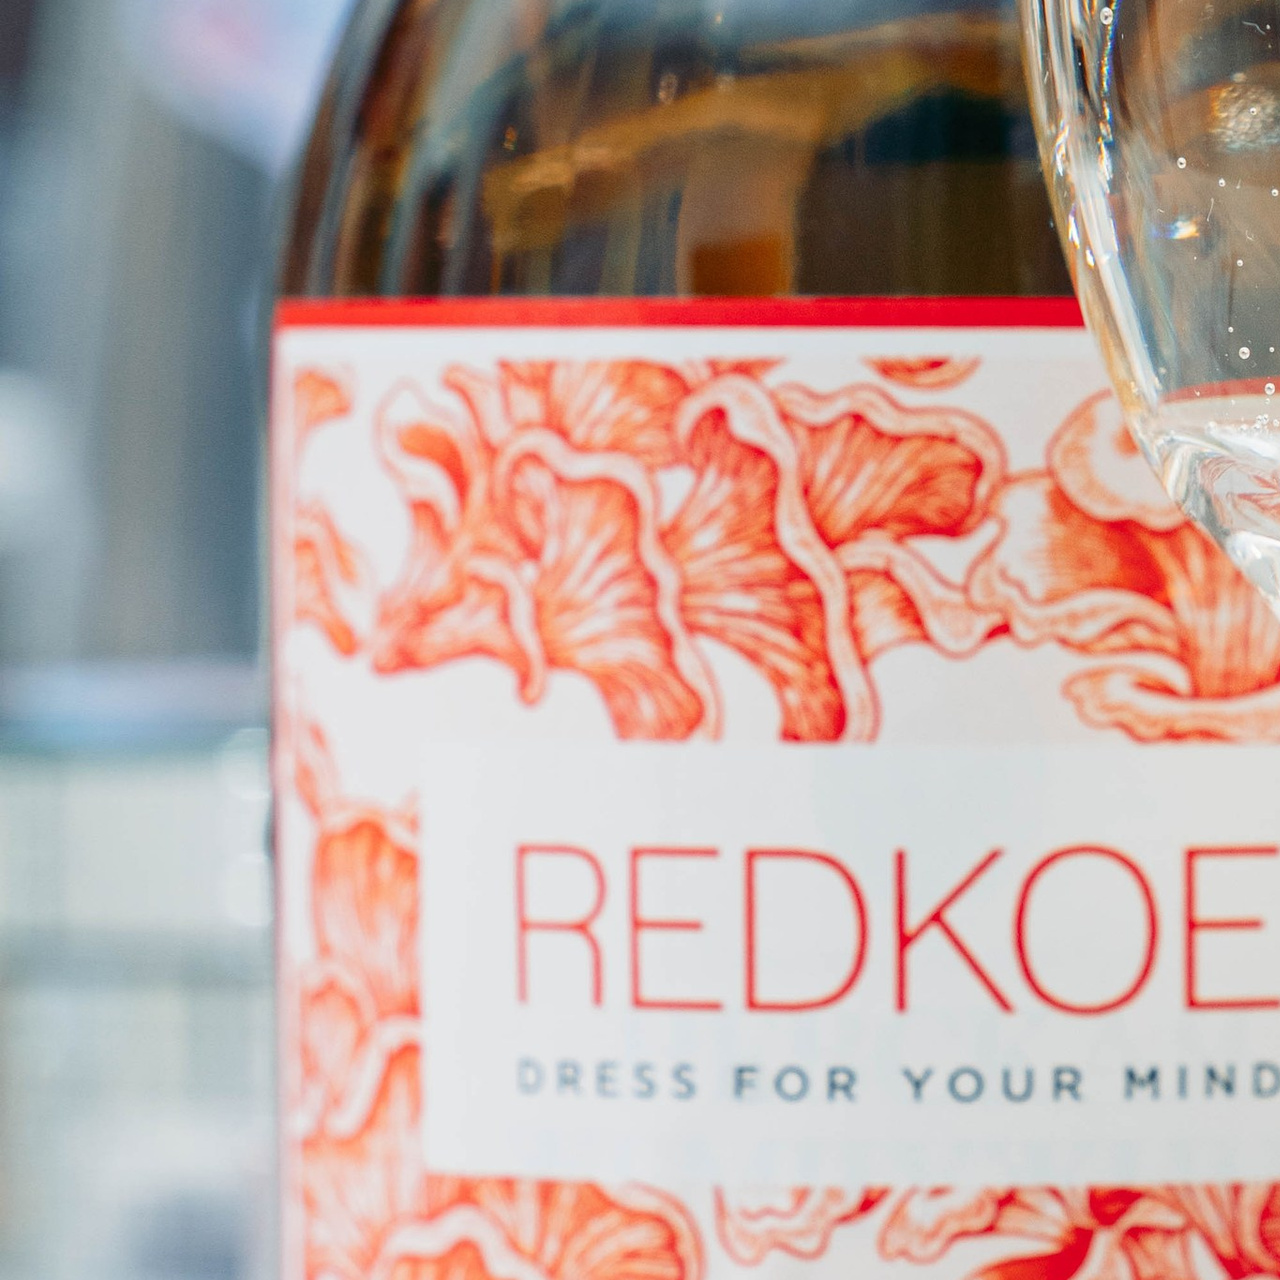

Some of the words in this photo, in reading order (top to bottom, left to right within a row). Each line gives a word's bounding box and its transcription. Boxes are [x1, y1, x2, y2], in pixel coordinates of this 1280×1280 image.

[516, 1057, 699, 1102] DRESS
[731, 1063, 860, 1104] FOR
[900, 1064, 1086, 1106] YOUR
